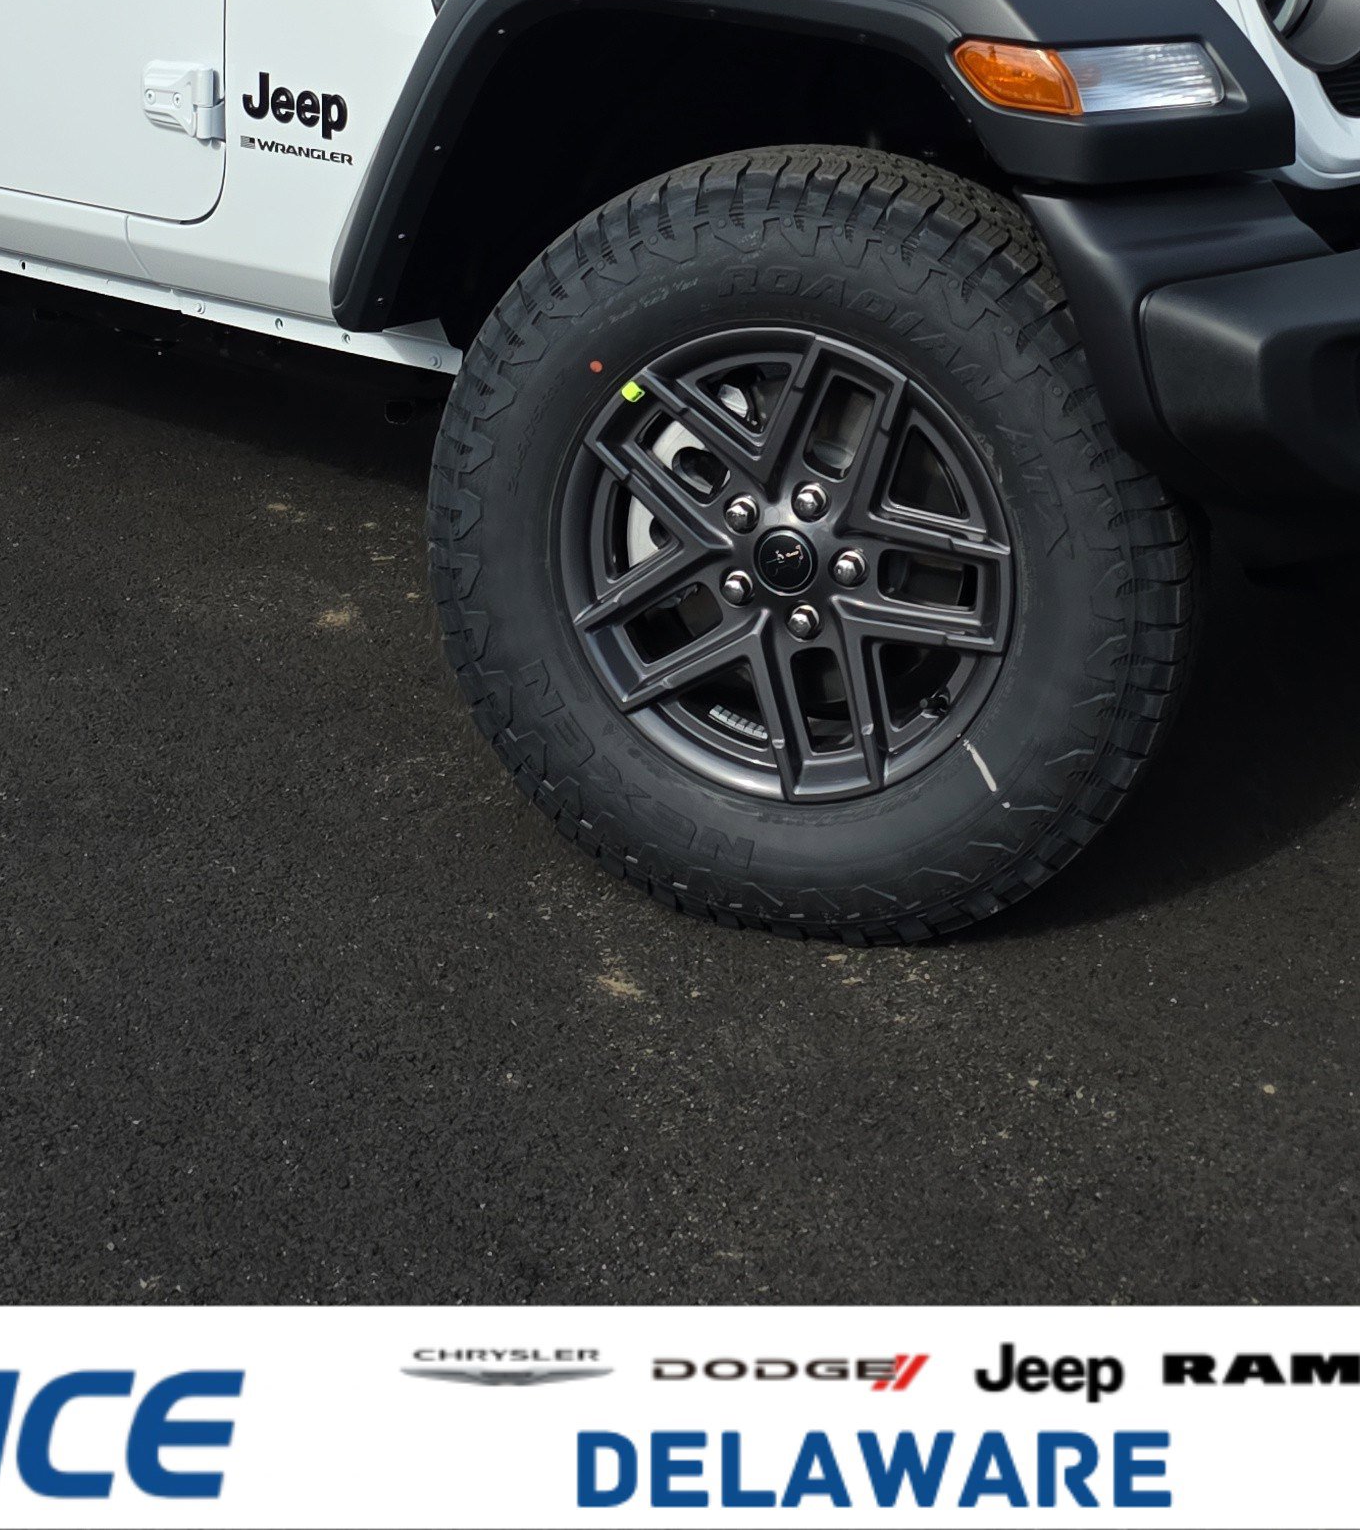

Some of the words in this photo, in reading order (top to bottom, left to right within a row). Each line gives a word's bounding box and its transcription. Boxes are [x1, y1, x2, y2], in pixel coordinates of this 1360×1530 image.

[242, 71, 348, 141] Jeep
[257, 138, 354, 166] WRANGLER
[716, 265, 1005, 405] ROADIAN
[516, 659, 757, 871] NEXEN
